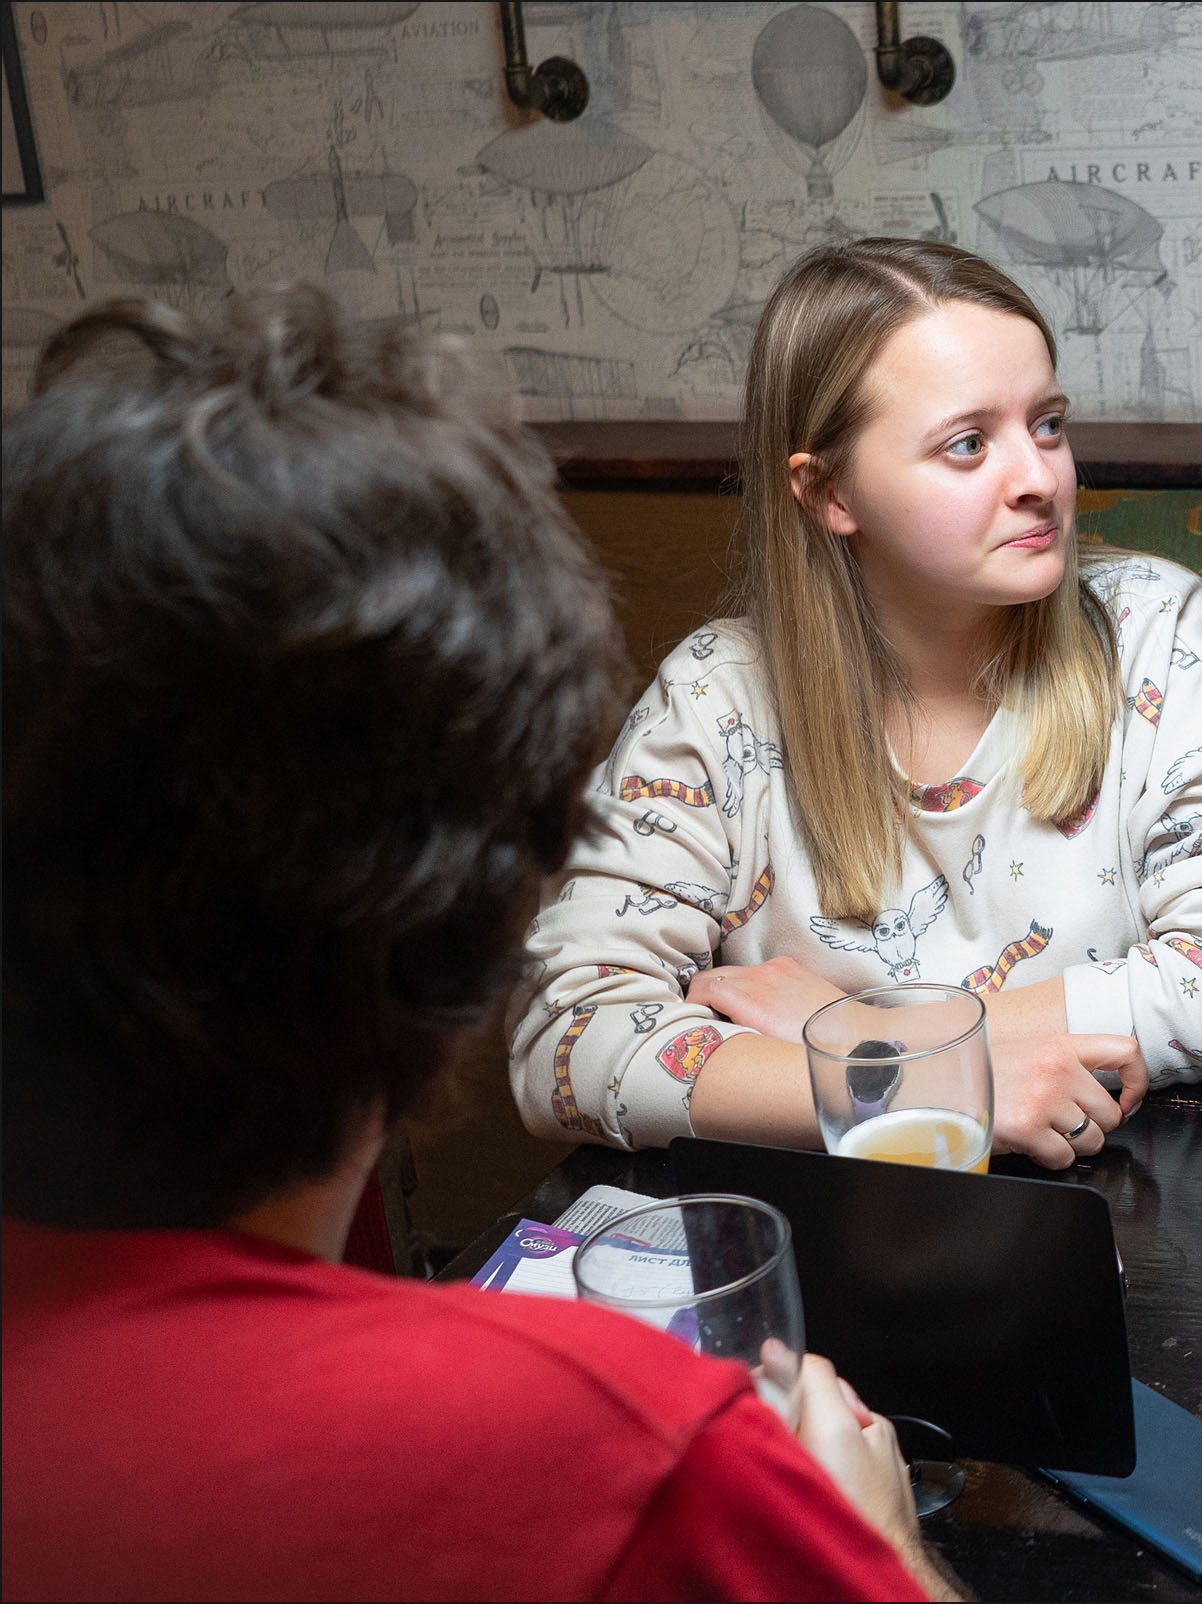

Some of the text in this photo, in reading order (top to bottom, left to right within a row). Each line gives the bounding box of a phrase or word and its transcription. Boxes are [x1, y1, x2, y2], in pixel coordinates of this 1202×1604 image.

[401, 19, 479, 40] AVIATION
[138, 190, 268, 213] AIRCRAFT
[520, 1238, 558, 1252] Смузи
